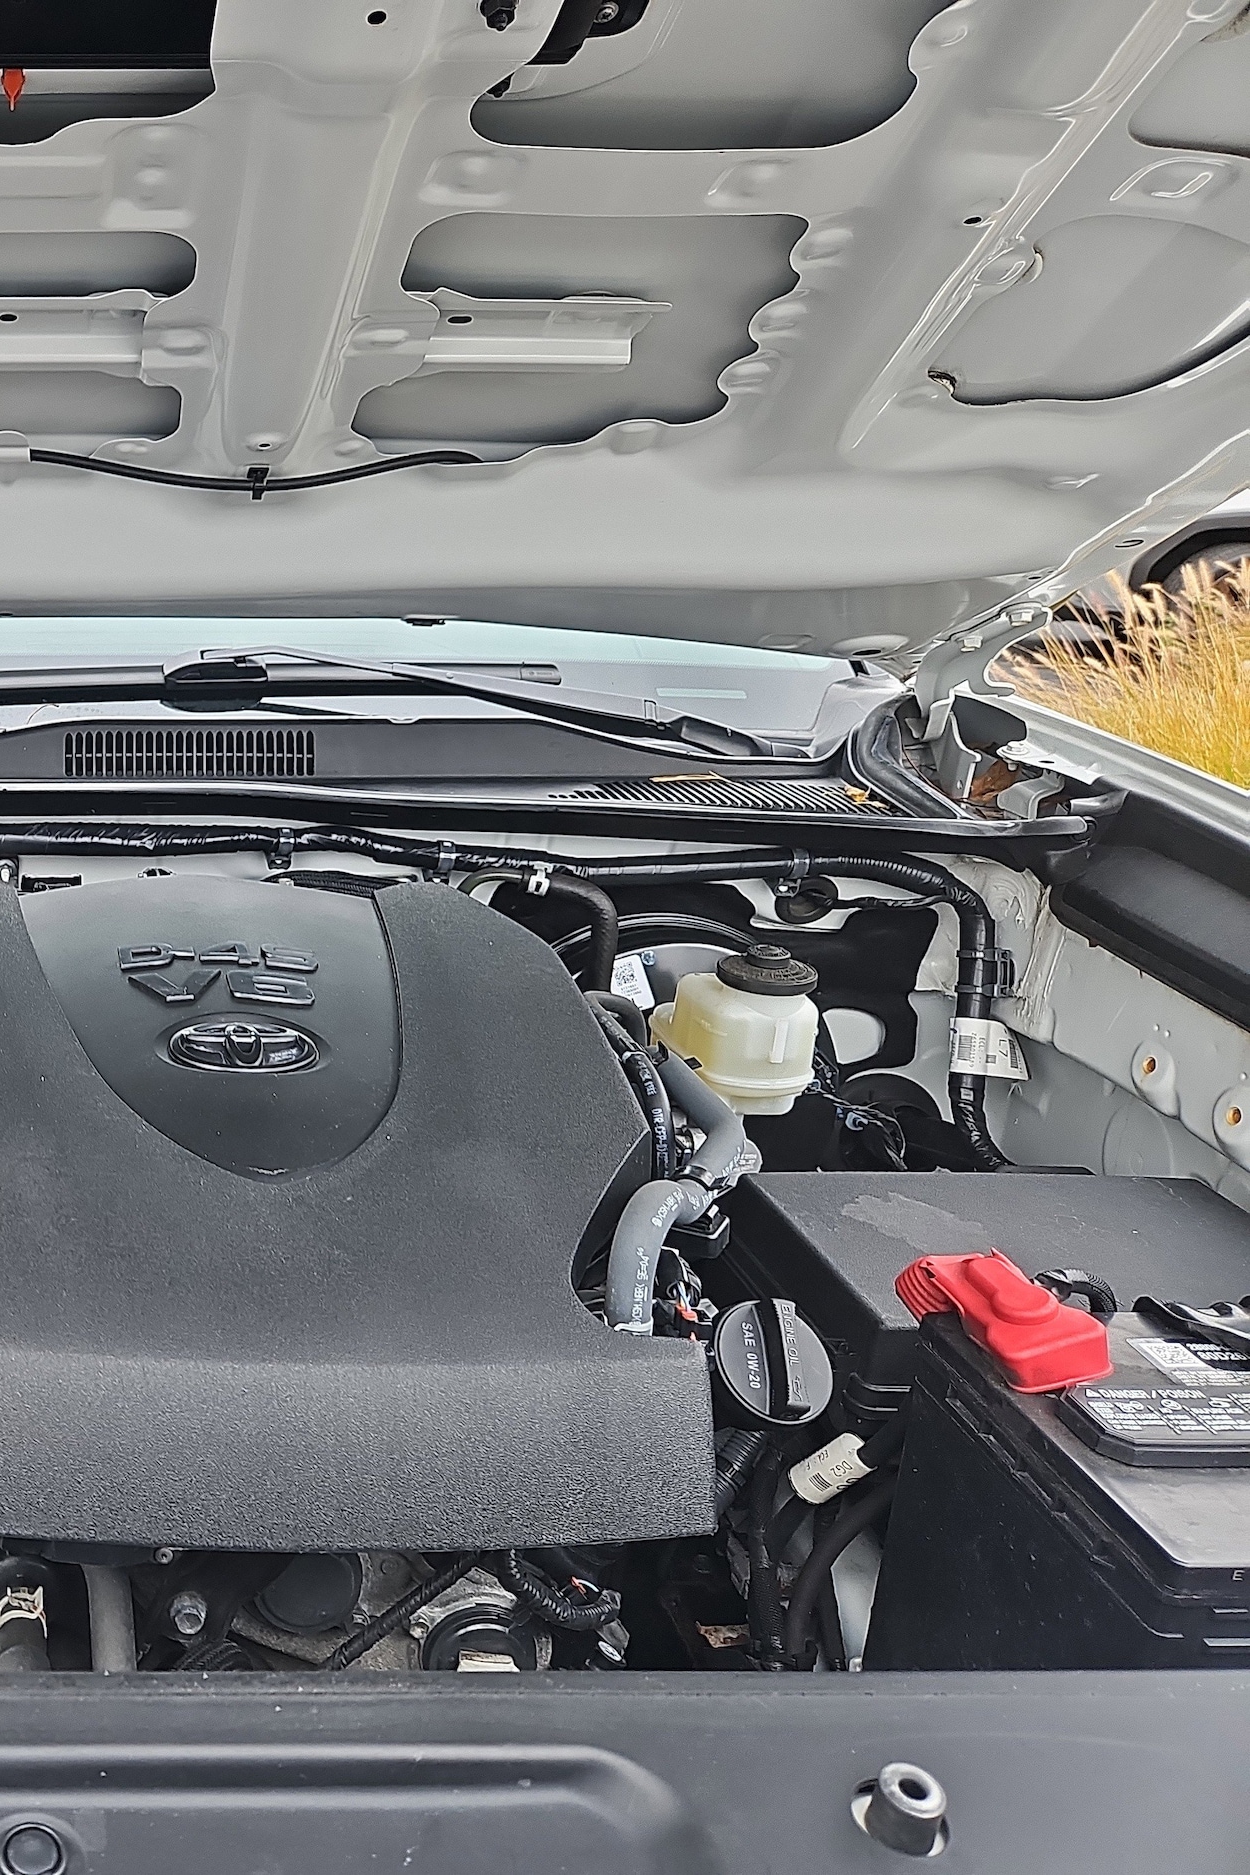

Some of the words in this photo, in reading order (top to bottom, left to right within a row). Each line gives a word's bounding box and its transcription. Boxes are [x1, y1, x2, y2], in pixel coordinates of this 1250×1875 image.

[117, 941, 319, 973] D-4S
[128, 970, 316, 1006] V6
[741, 1321, 756, 1347] SAE
[781, 1304, 796, 1345] ENGINE
[746, 1352, 762, 1389] 0W-20
[787, 1347, 800, 1366] OIL
[1097, 1389, 1151, 1399] DANGER
[1156, 1389, 1207, 1399] POISON
[829, 1460, 854, 1477] DG2
